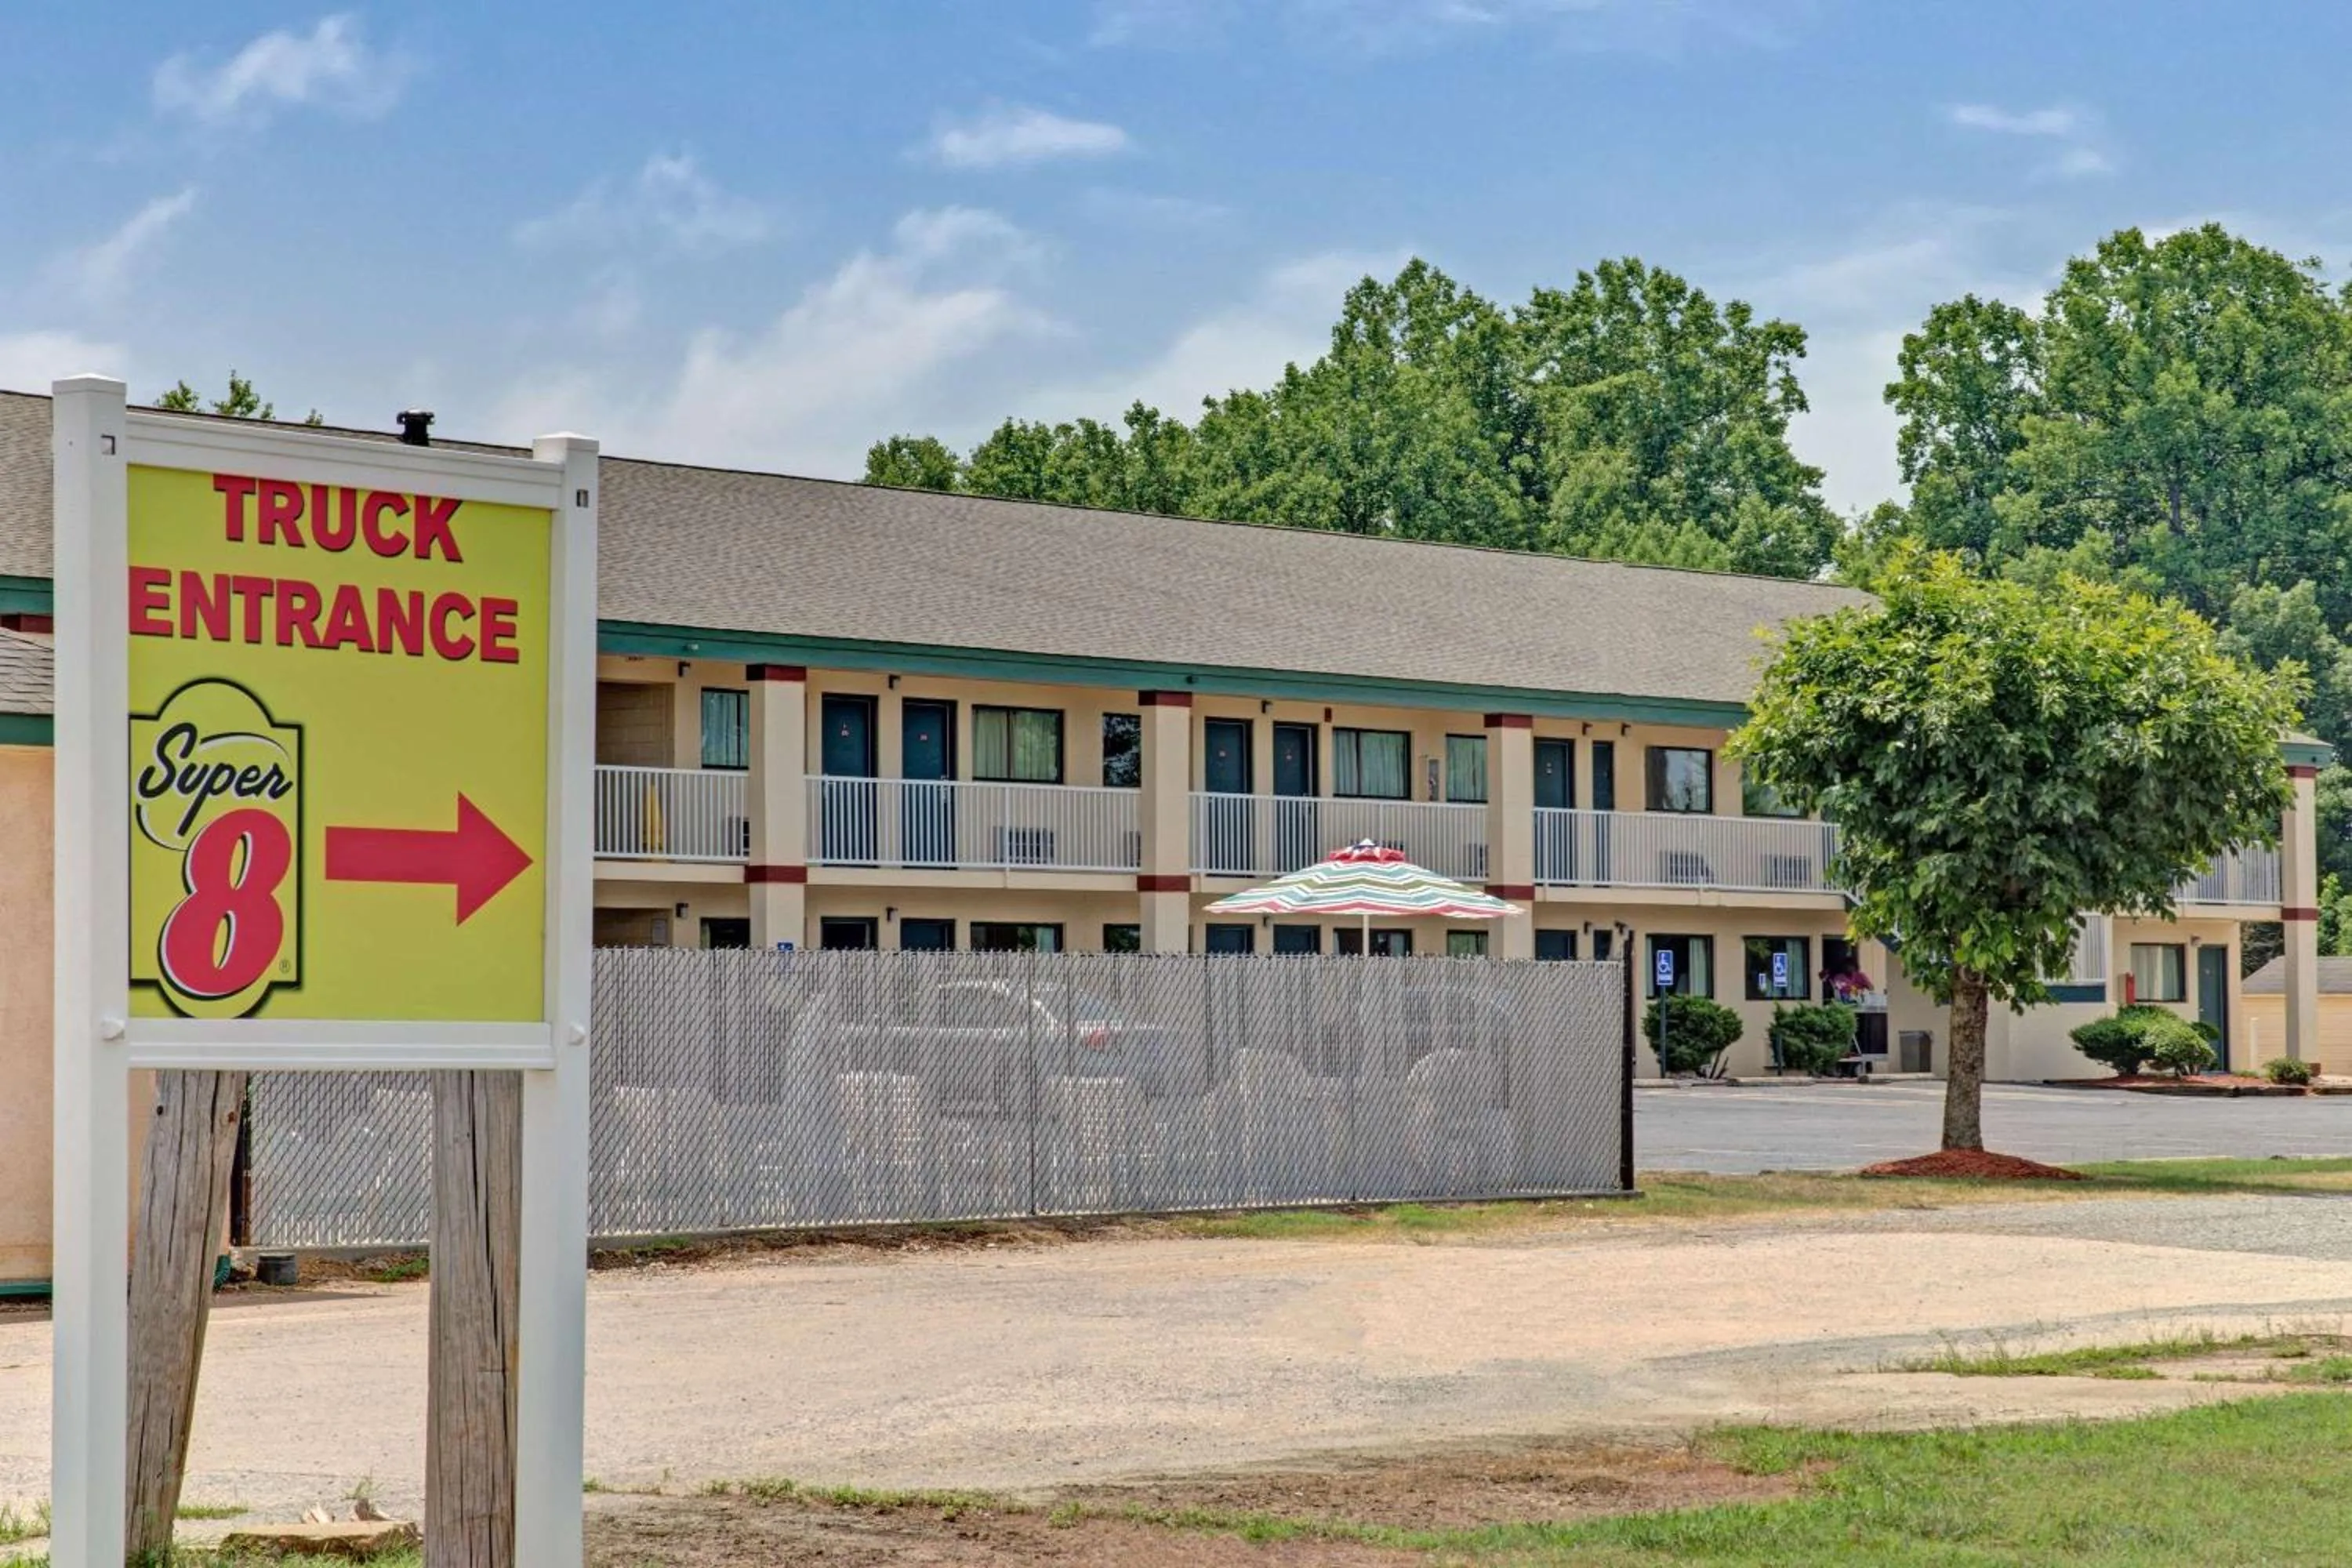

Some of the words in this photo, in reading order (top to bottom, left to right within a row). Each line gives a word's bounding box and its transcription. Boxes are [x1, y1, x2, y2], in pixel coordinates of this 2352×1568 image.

[213, 474, 463, 562] TRUCK
[129, 566, 519, 663] ENTRANCE
[138, 721, 293, 837] Super
[158, 808, 292, 1000] 8
